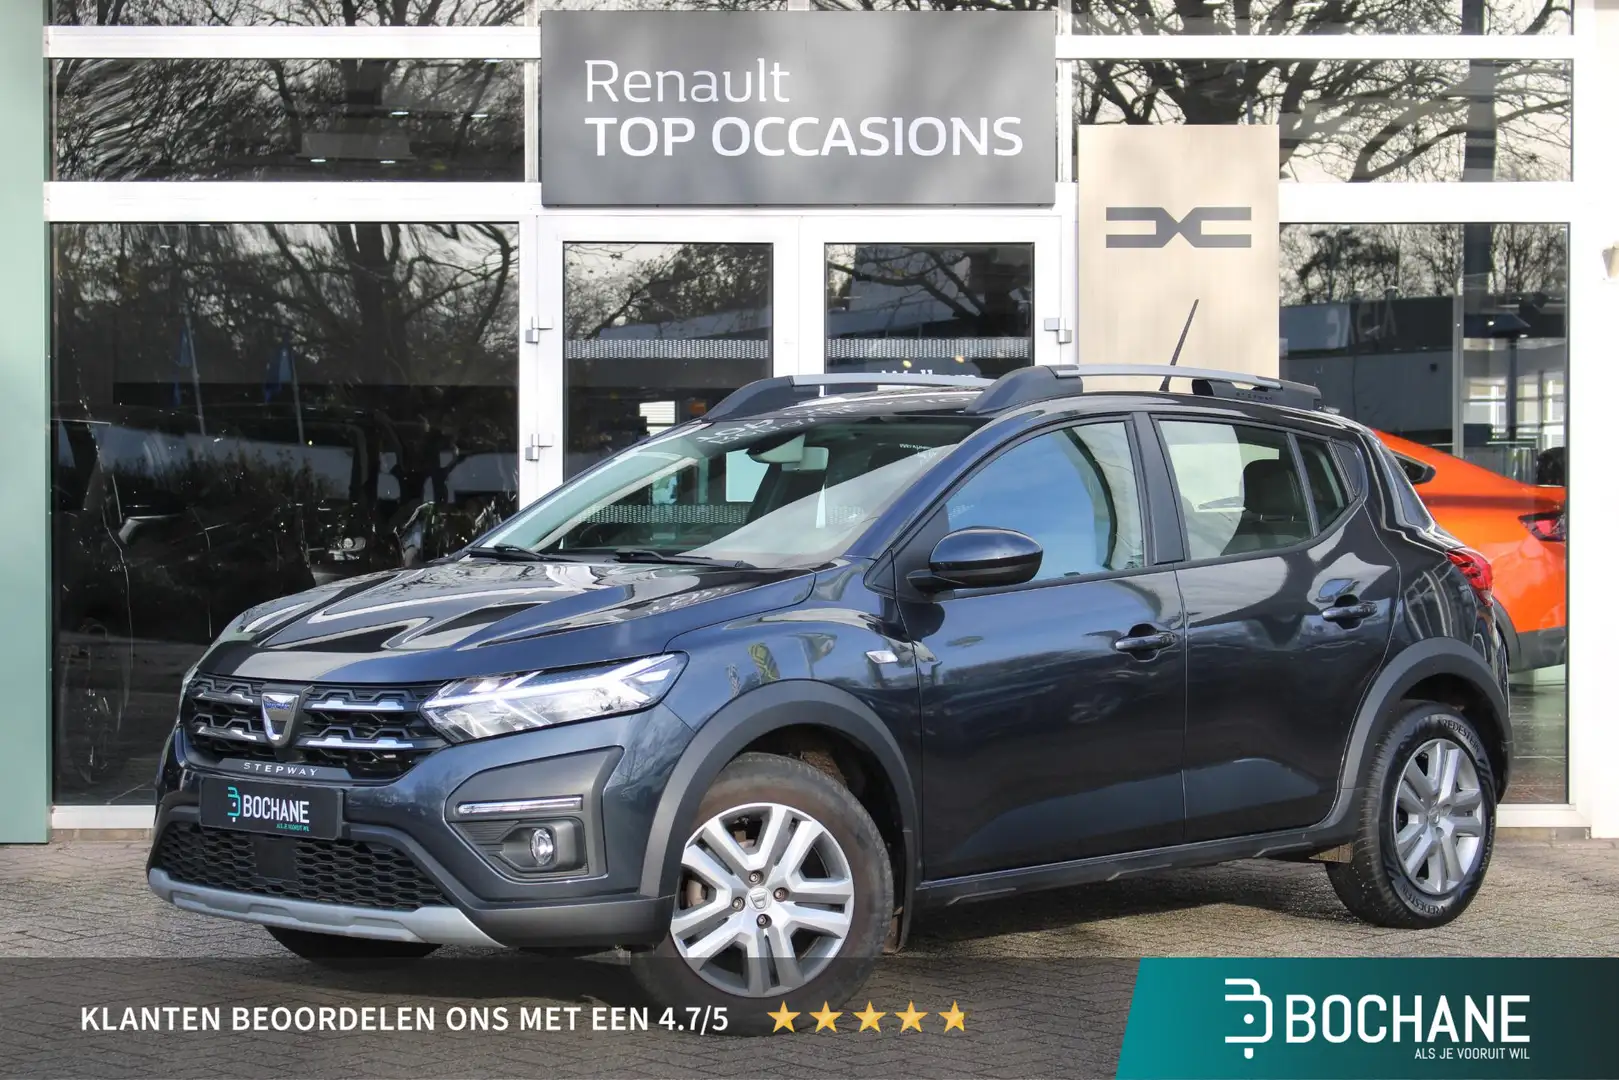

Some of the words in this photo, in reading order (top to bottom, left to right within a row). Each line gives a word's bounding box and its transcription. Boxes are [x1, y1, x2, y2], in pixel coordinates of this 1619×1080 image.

[584, 57, 791, 103] Renault
[584, 116, 696, 157] TOP
[711, 116, 1024, 157] OCCASIONS
[243, 762, 318, 776] STEPWAY
[243, 794, 310, 824] BOCHANE
